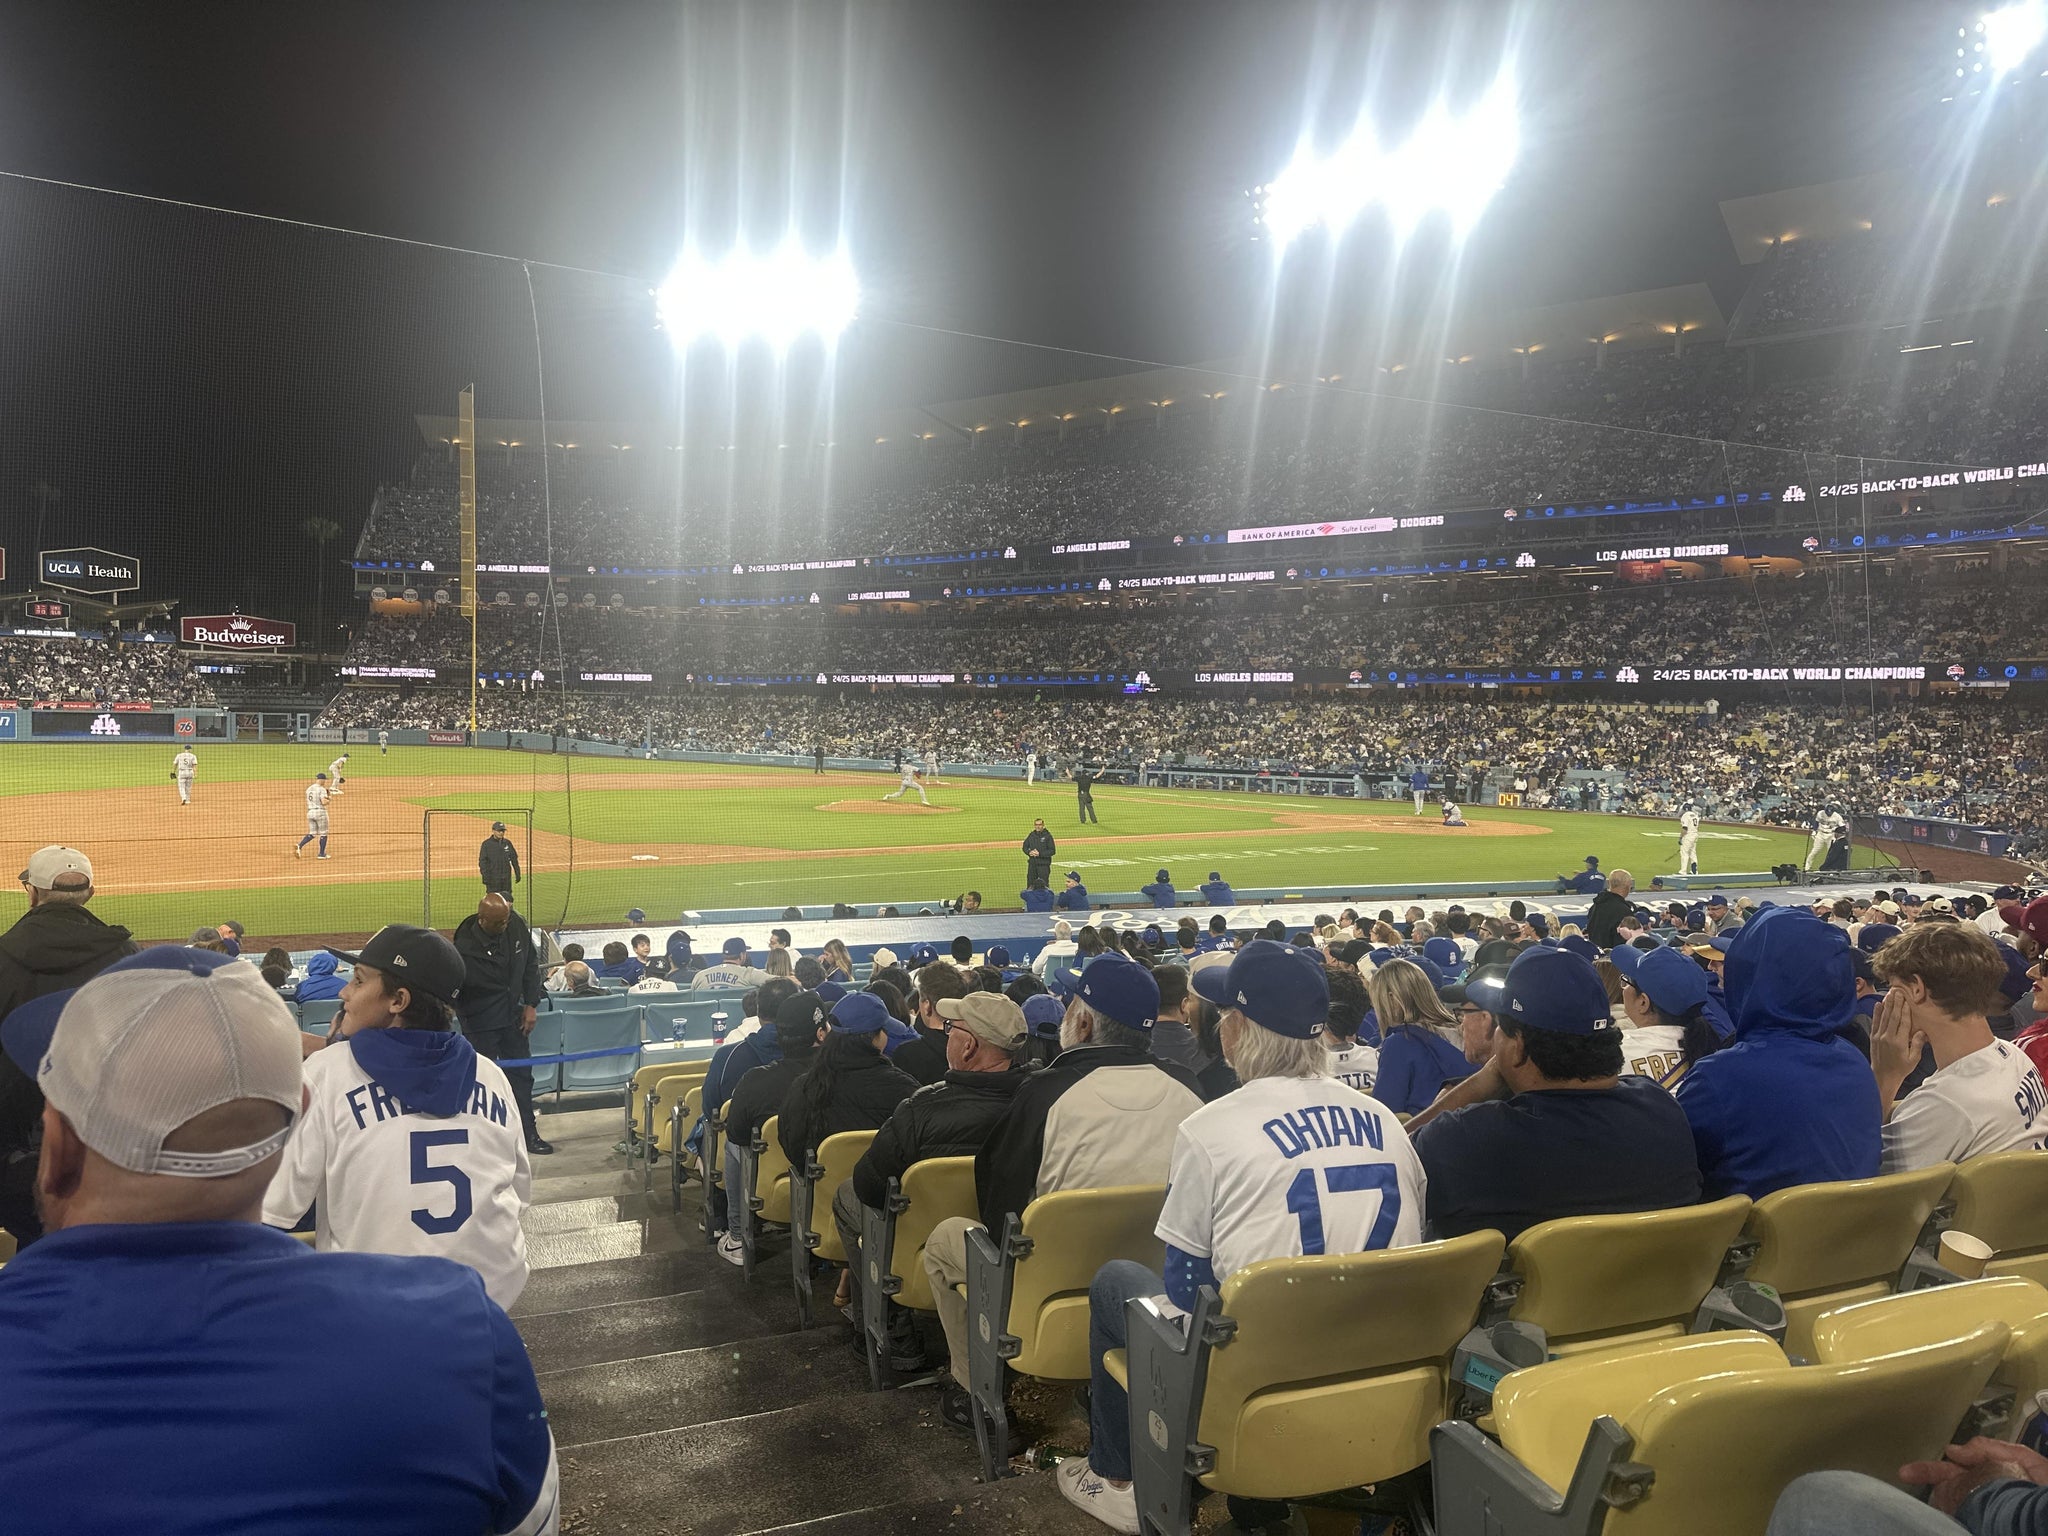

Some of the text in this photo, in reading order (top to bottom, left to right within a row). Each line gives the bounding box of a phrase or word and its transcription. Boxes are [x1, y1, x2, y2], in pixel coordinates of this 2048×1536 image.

[1819, 483, 1859, 497] 24/25
[1861, 472, 1960, 494] BACK-TO-BACK
[1963, 466, 2014, 483] WORLD
[1341, 523, 1377, 533] Suite Level
[1400, 516, 1444, 528] DODGERS
[1242, 533, 1263, 541] BANK
[1278, 528, 1316, 538] AMERICA
[1051, 546, 1065, 554] LOS
[1067, 543, 1096, 553] ANGELES
[1596, 544, 1729, 562] LOS ANGELES DODGERS
[48, 562, 132, 579] UCLA Health
[487, 565, 519, 573] ANGELES
[748, 560, 856, 573] 24/25 BACK-TO-BACK WORLD CHAMPIONS
[1118, 570, 1275, 588] 24/25 BACK-TO-BACK WORLD CHAMPIONS
[848, 590, 910, 601] LOS ANGELES DODGERS
[580, 673, 593, 682] LOS
[593, 673, 623, 682] ANGELES
[832, 674, 955, 683] 24/25 BACK-TO-BACK WORLD CHAMPIONS
[1195, 672, 1294, 682] LOS ANGELES DODGERS
[1652, 667, 1926, 681] 24/25 BACK-TO-BACK WORLD CHAMPIONS
[178, 722, 192, 733] 76
[430, 734, 462, 742] Yakult
[705, 972, 739, 985] TURNER
[1262, 1105, 1384, 1160] OHTANI
[409, 1128, 473, 1236] 5
[1286, 1162, 1402, 1256] 17
[1468, 1365, 1499, 1385] Uber Ea
